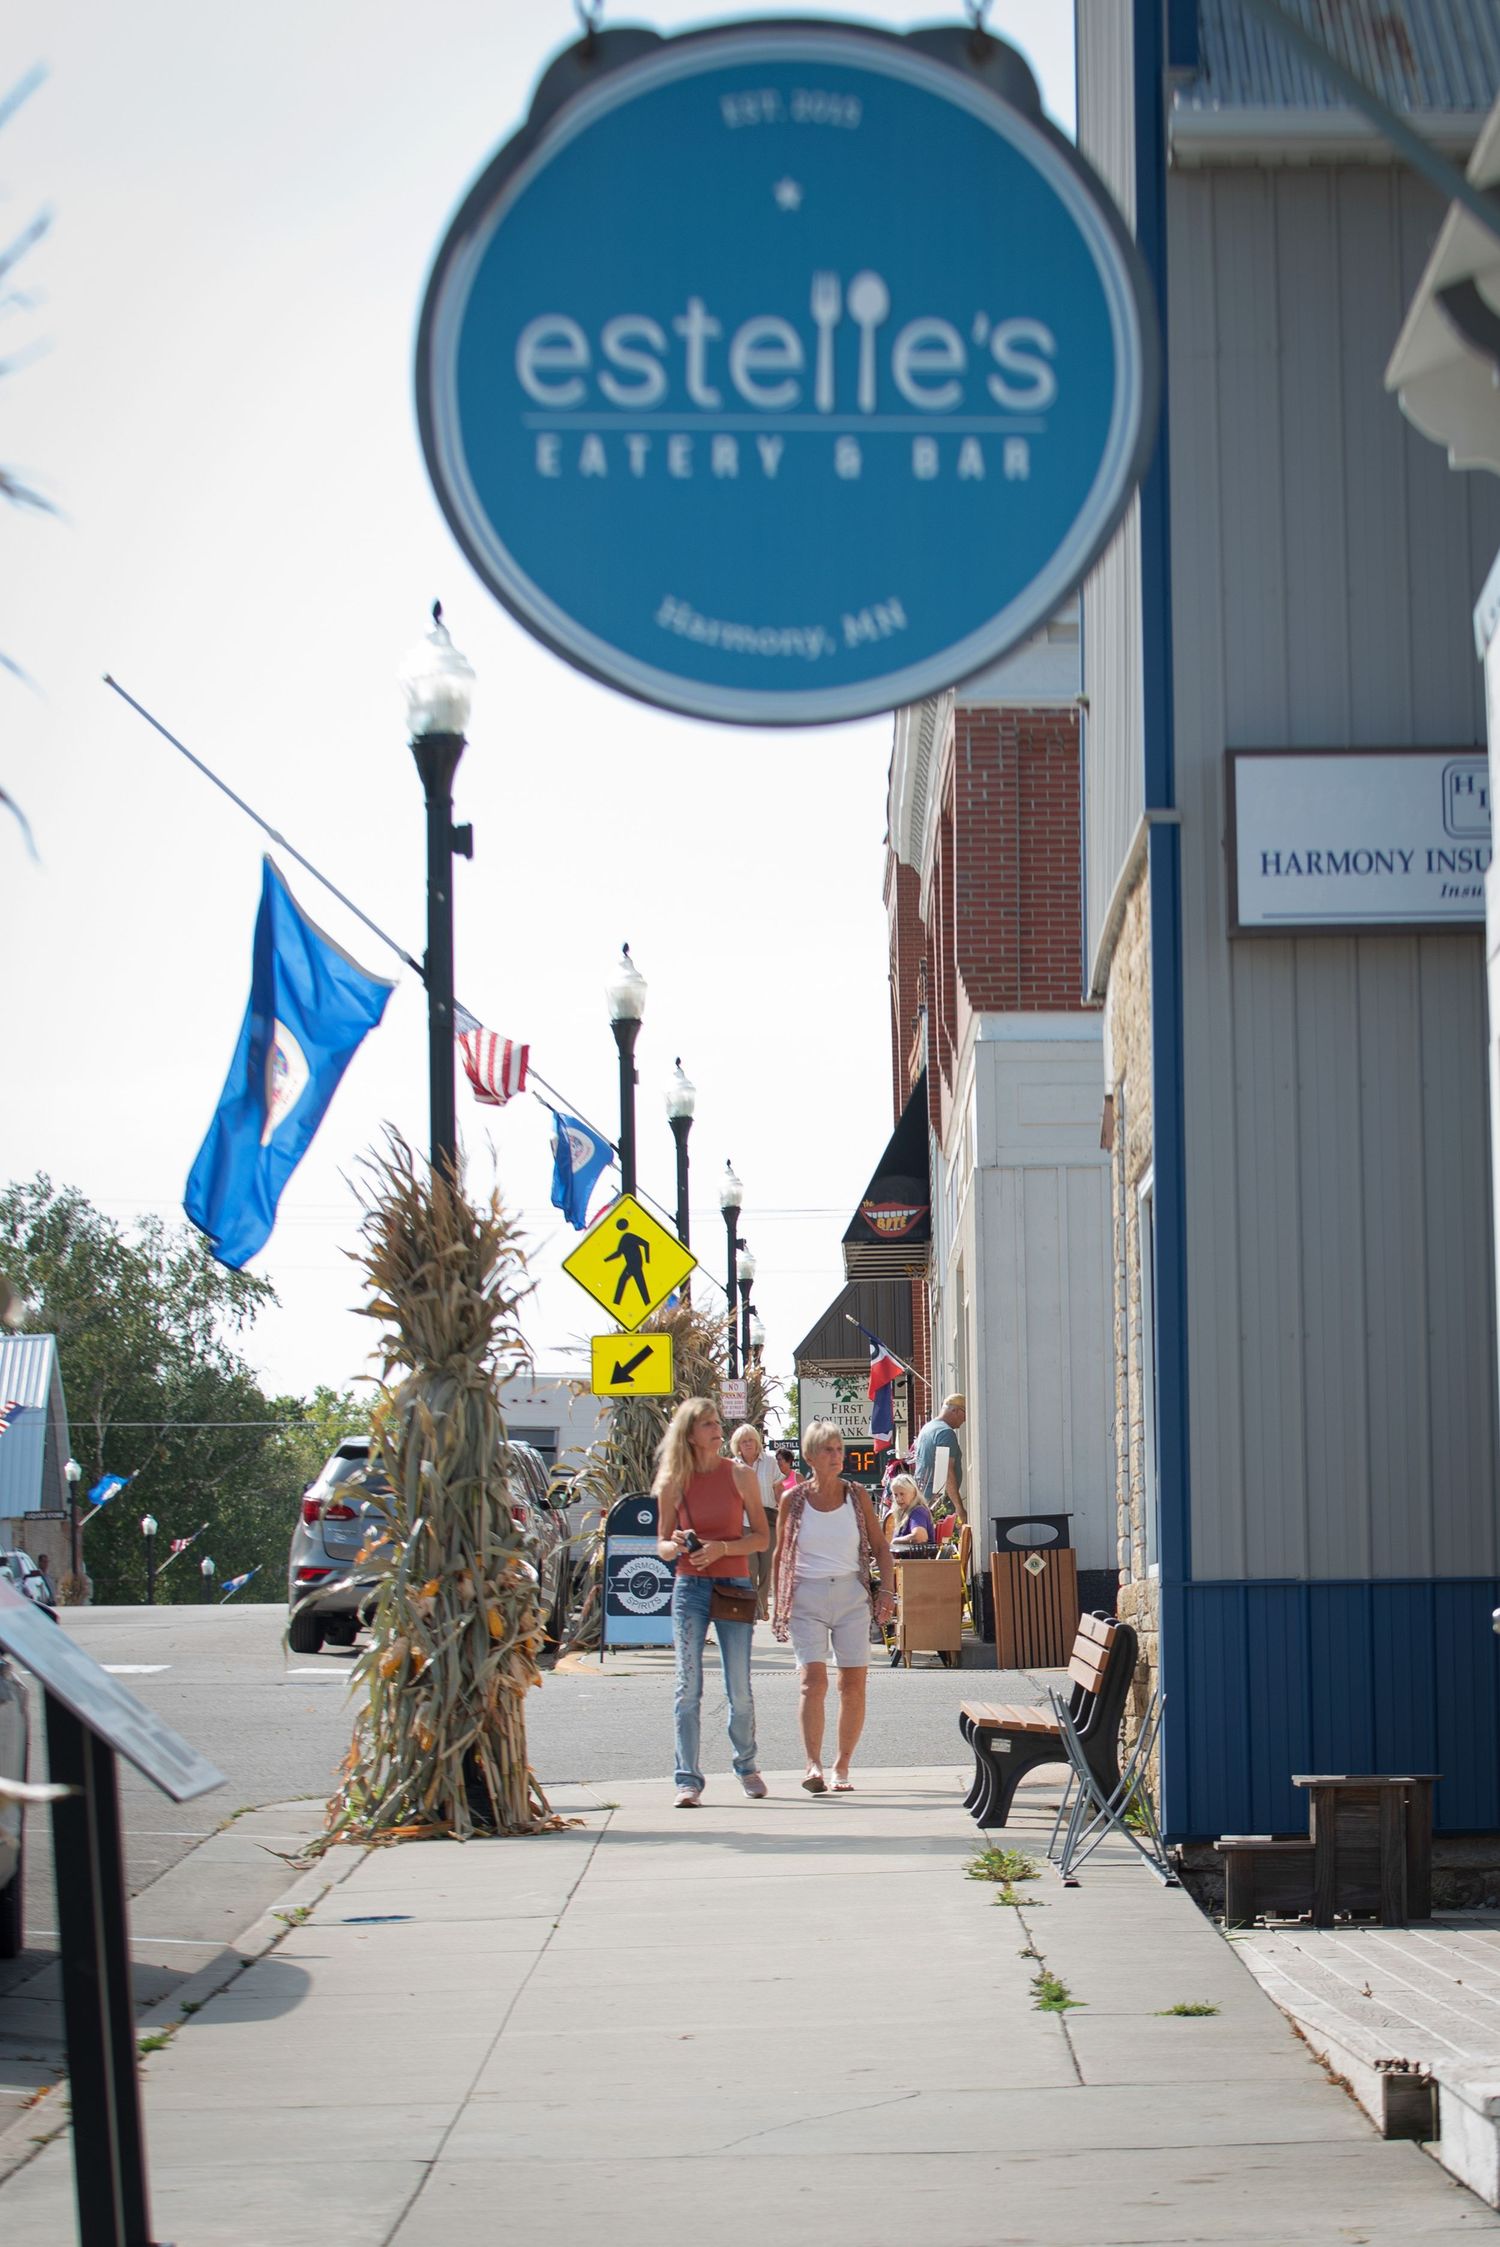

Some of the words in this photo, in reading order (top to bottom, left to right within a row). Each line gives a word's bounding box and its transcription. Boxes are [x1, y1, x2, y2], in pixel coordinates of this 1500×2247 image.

[515, 268, 1058, 412] estelle's
[535, 432, 784, 478] EATERY
[834, 435, 862, 480] &
[912, 435, 1030, 481] BAR
[655, 594, 836, 661] Harmony,
[842, 596, 907, 649] MN
[1261, 849, 1414, 877] HARMONY
[1425, 847, 1492, 875] INSU
[862, 1200, 874, 1208] the
[876, 1216, 907, 1230] BITE
[831, 1403, 863, 1414] FIRST
[840, 1427, 864, 1437] ANK
[624, 1562, 666, 1576] HARMONY
[626, 1597, 662, 1609] SPIRITS
